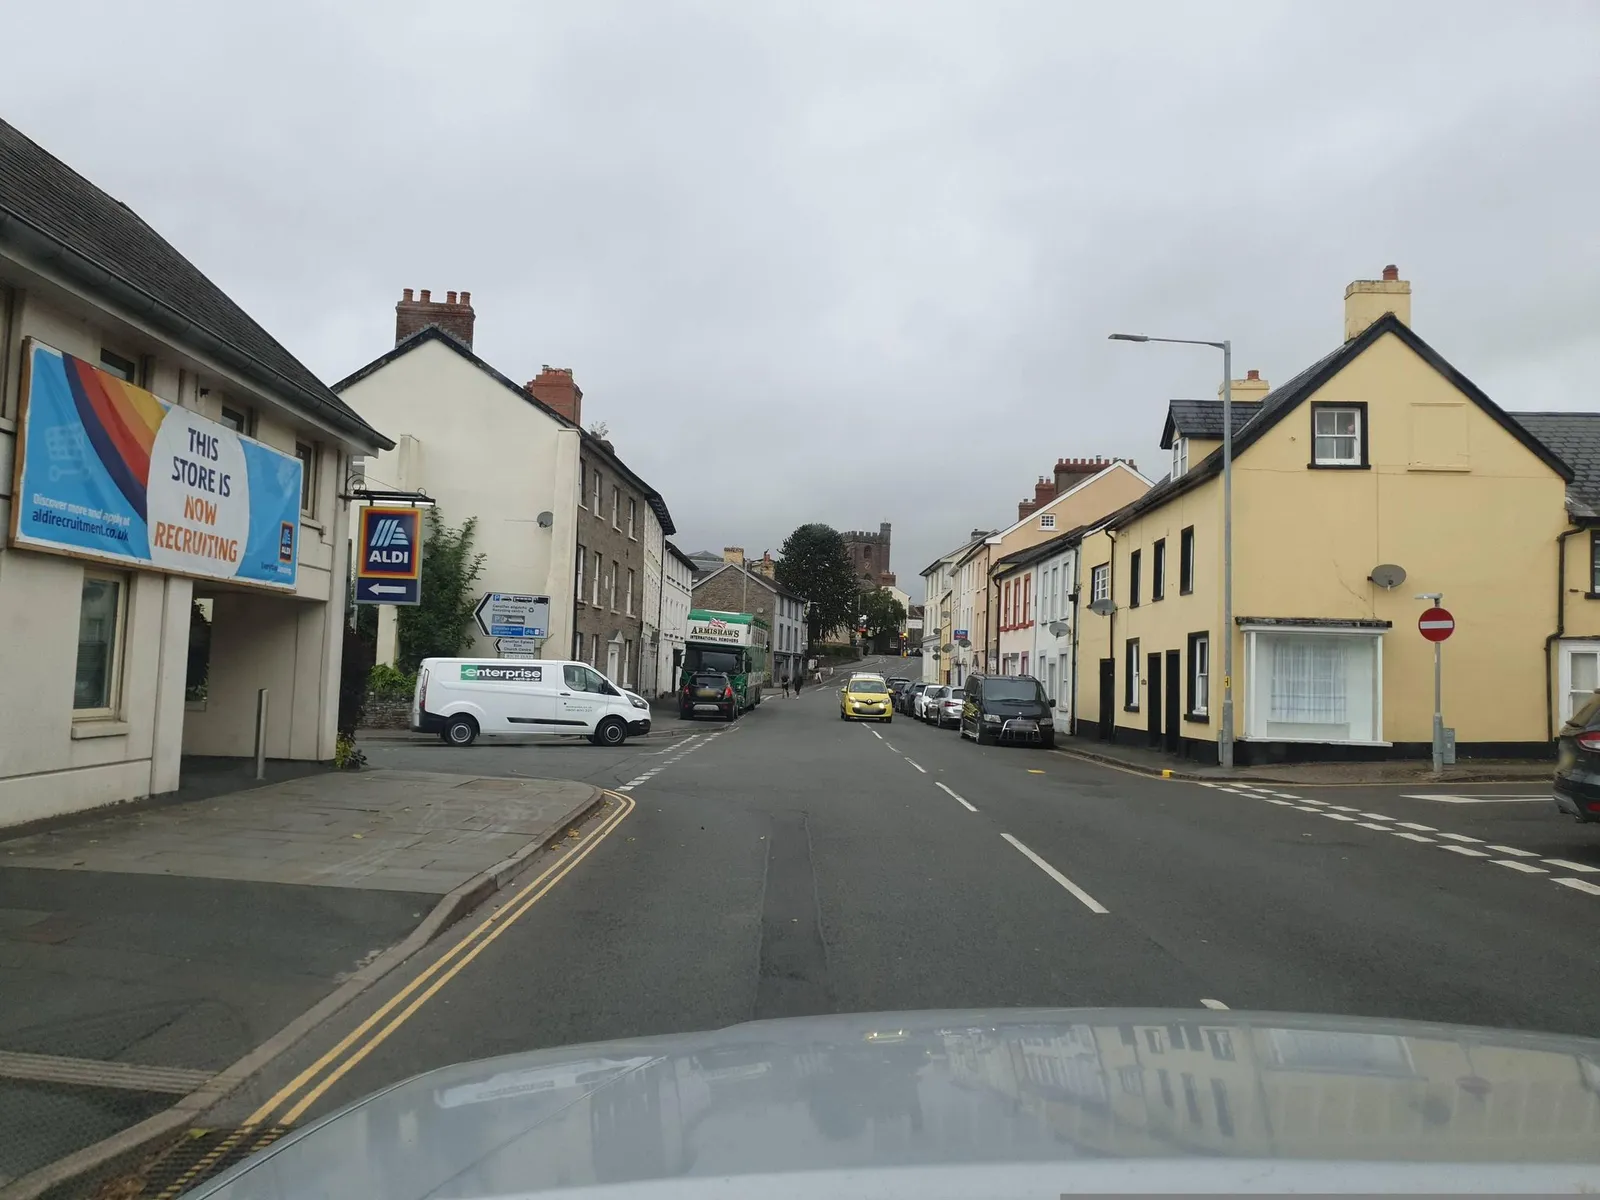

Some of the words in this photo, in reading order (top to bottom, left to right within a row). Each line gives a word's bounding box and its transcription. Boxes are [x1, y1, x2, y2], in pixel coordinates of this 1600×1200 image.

[187, 427, 219, 462] THIS
[171, 456, 215, 494] STORE
[219, 472, 231, 498] IS
[33, 493, 67, 511] Discover
[68, 503, 88, 516] more
[88, 508, 103, 520] and
[184, 494, 217, 526] NOW
[32, 508, 129, 541] aldirecruitment.co.uk
[154, 521, 238, 563] RECRUITING
[369, 550, 409, 564] ALDI
[691, 626, 740, 638] ARMISHAWS
[463, 668, 541, 679] enterprise
